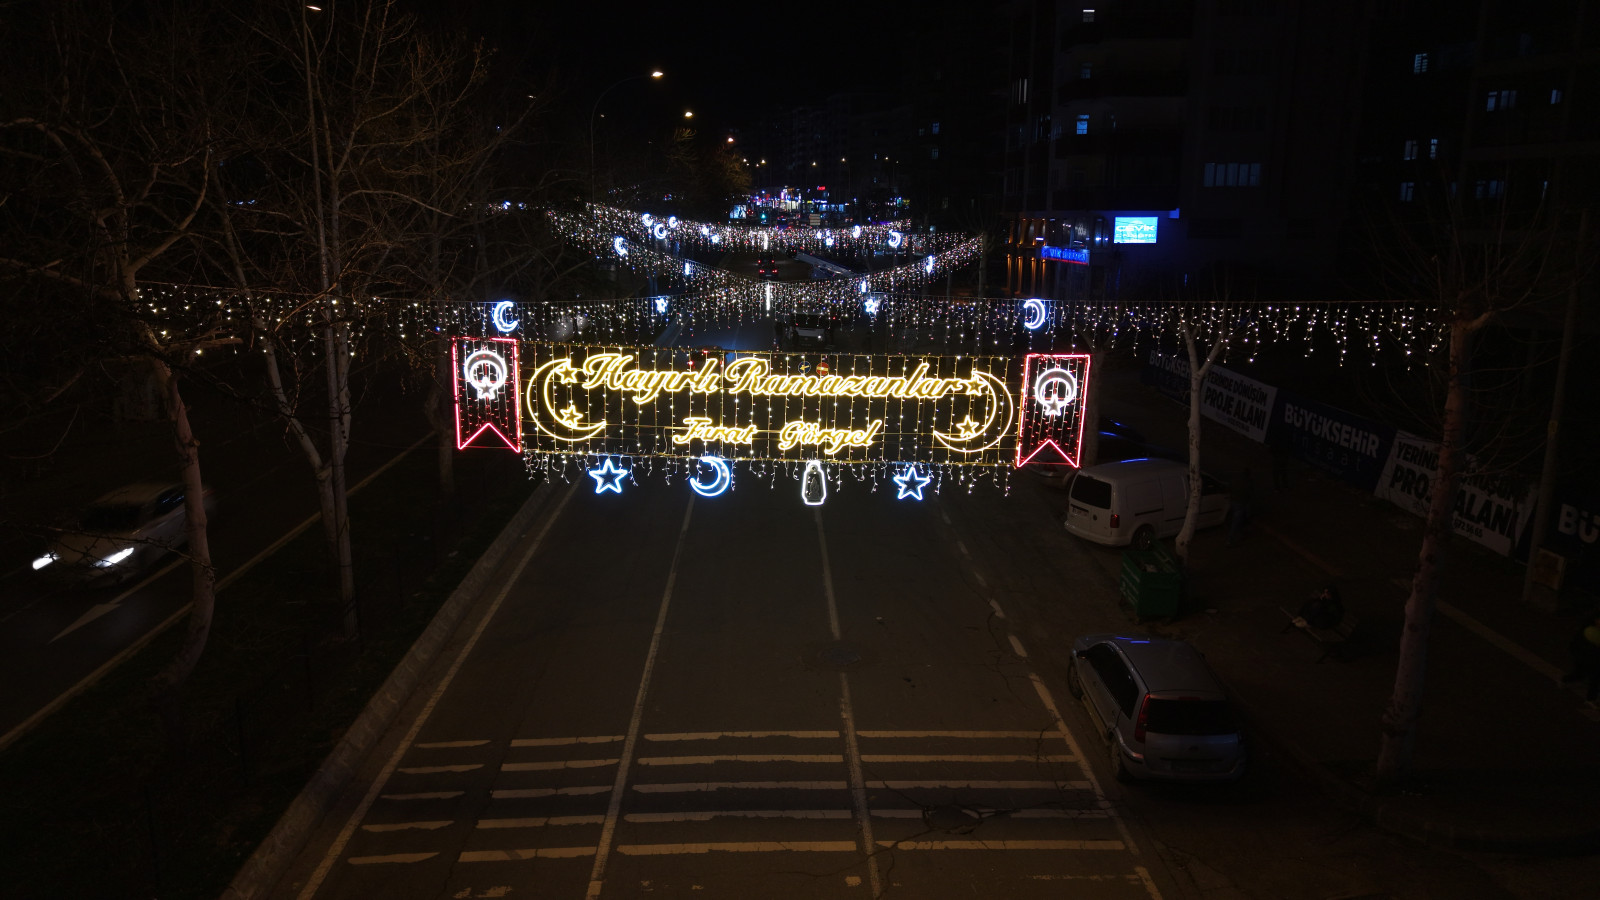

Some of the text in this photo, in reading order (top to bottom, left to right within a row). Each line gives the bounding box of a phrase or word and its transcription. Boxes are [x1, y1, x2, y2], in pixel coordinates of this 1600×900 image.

[581, 352, 963, 403] Hayırlı Ramazanlar
[1203, 386, 1235, 415] PROJE
[1233, 399, 1267, 431] ALANI
[1284, 402, 1380, 459] BÜYÜKŞEHİR
[778, 419, 882, 454] Görgel
[1397, 441, 1440, 472] YERİND
